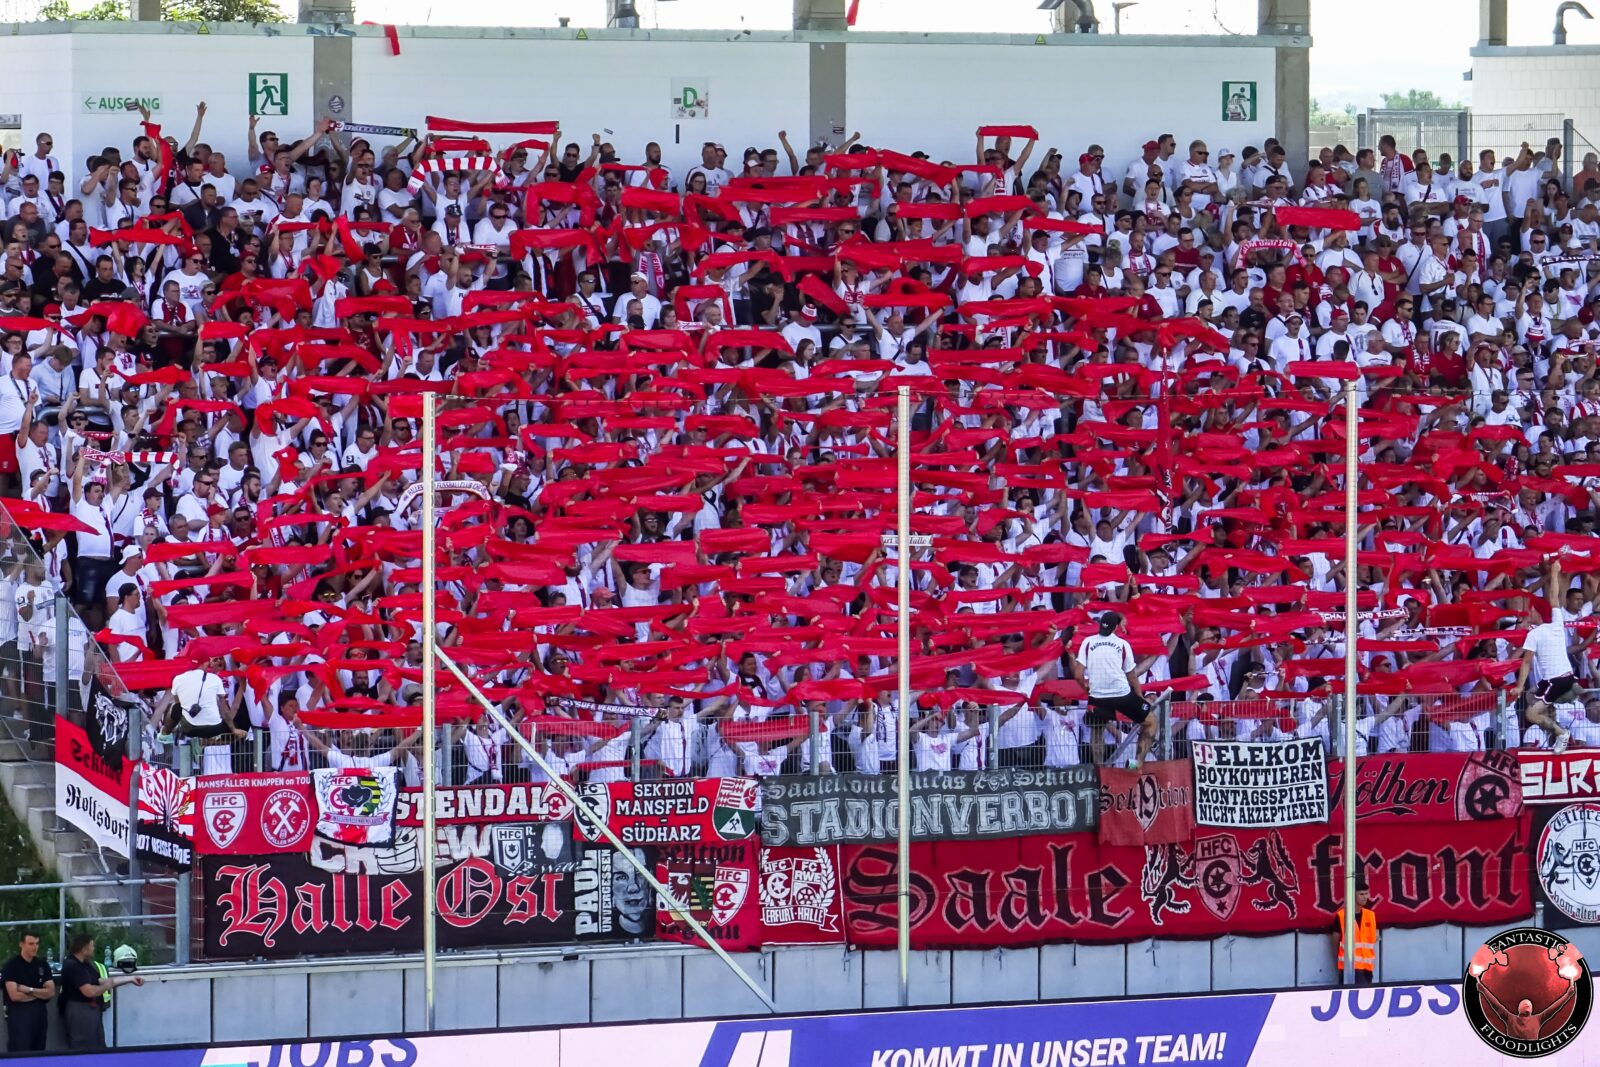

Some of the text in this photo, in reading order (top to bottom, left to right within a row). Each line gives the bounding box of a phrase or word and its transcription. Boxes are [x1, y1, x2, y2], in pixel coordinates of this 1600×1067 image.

[1194, 740, 1322, 767] TELEKOM
[1196, 761, 1323, 787] BOYKOTTIEREN
[1481, 750, 1522, 779] HFC
[251, 778, 285, 787] KNAPPEN
[633, 781, 695, 798] SEKTION
[211, 796, 238, 806] HFC
[395, 786, 549, 821] STENDAL
[1198, 783, 1325, 806] MONTAGSSPIELE
[615, 796, 710, 816] MANSFELD
[1199, 801, 1325, 825] NICHT AKZEPTIEREN
[760, 787, 1101, 847] STADIONVERBOT
[499, 830, 522, 839] HFC
[621, 822, 702, 843] SÜDHARZ
[1200, 837, 1233, 858] HFC
[1575, 841, 1595, 851] HFC
[715, 869, 743, 881] HFC
[763, 860, 787, 873] HFC
[794, 869, 822, 883] RWE
[801, 861, 818, 873] FC
[573, 848, 600, 936] PAUL
[600, 848, 613, 933] UNVERGESSEN
[844, 830, 1534, 935] Saale front
[214, 856, 564, 948] Halle Ost
[797, 906, 824, 923] HALLE
[870, 1031, 1227, 1067] KOMMT IN UNSER TEAM!
